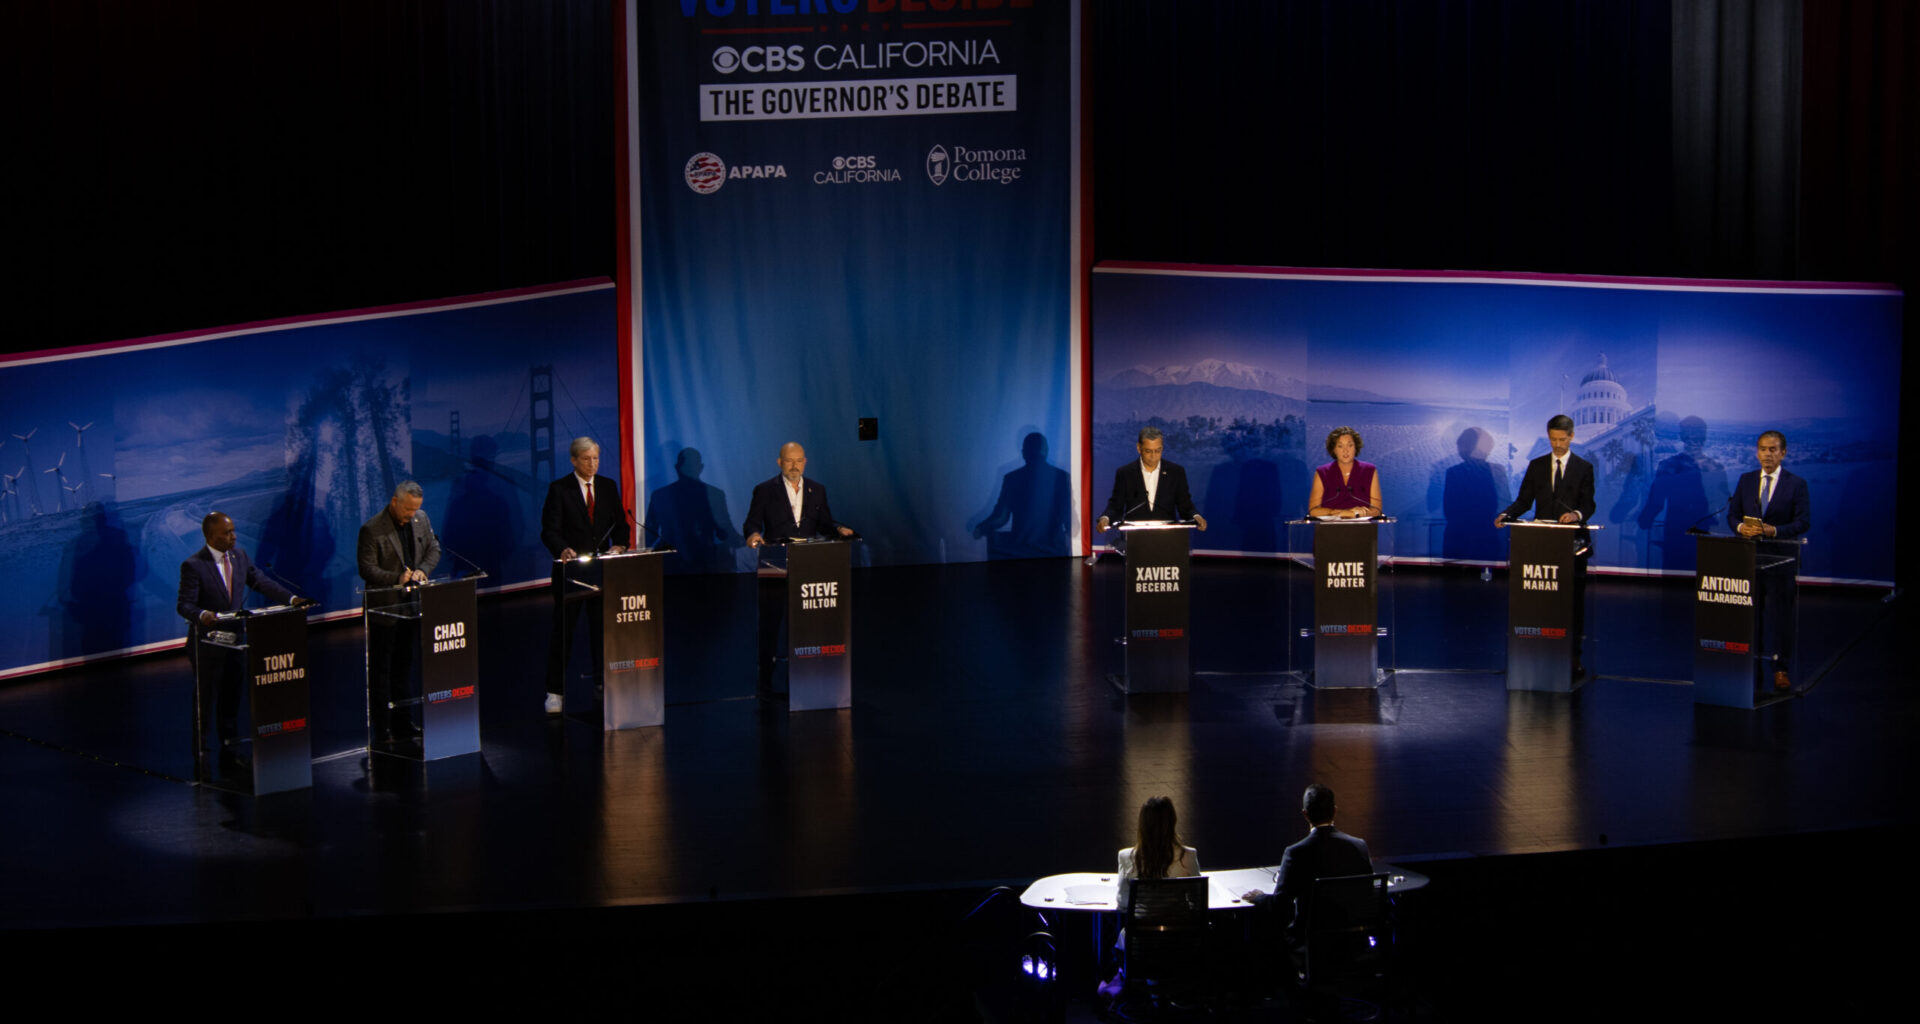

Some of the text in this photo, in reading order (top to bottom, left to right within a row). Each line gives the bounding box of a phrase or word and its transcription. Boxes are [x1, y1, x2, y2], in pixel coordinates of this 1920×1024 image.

[740, 39, 1001, 73] CBS CALIFORNIA
[709, 89, 755, 116] THE
[916, 81, 1005, 109] DEBATE
[845, 155, 876, 169] CBS
[953, 145, 1027, 163] Pomona
[728, 165, 788, 179] APAPA
[813, 168, 902, 184] CALIFORNIA
[953, 163, 1022, 185] College
[1135, 566, 1181, 581] XAVIER
[1327, 562, 1365, 577] KATIE
[1522, 564, 1560, 580] MATT
[800, 581, 838, 598] STEVE
[1135, 582, 1181, 593] BECERRA
[1327, 578, 1366, 588] PORTER
[1523, 580, 1559, 591] MAHAN
[1701, 575, 1750, 595] ANTONIO
[620, 594, 647, 611] TOM
[802, 598, 837, 610] HILTON
[1697, 590, 1754, 606] VILLARAIGOSA
[616, 610, 651, 623] STEYER
[434, 621, 465, 641] CHAD
[433, 637, 467, 653] BIANCO
[263, 652, 295, 672] TONY
[255, 667, 305, 686] THURMOND
